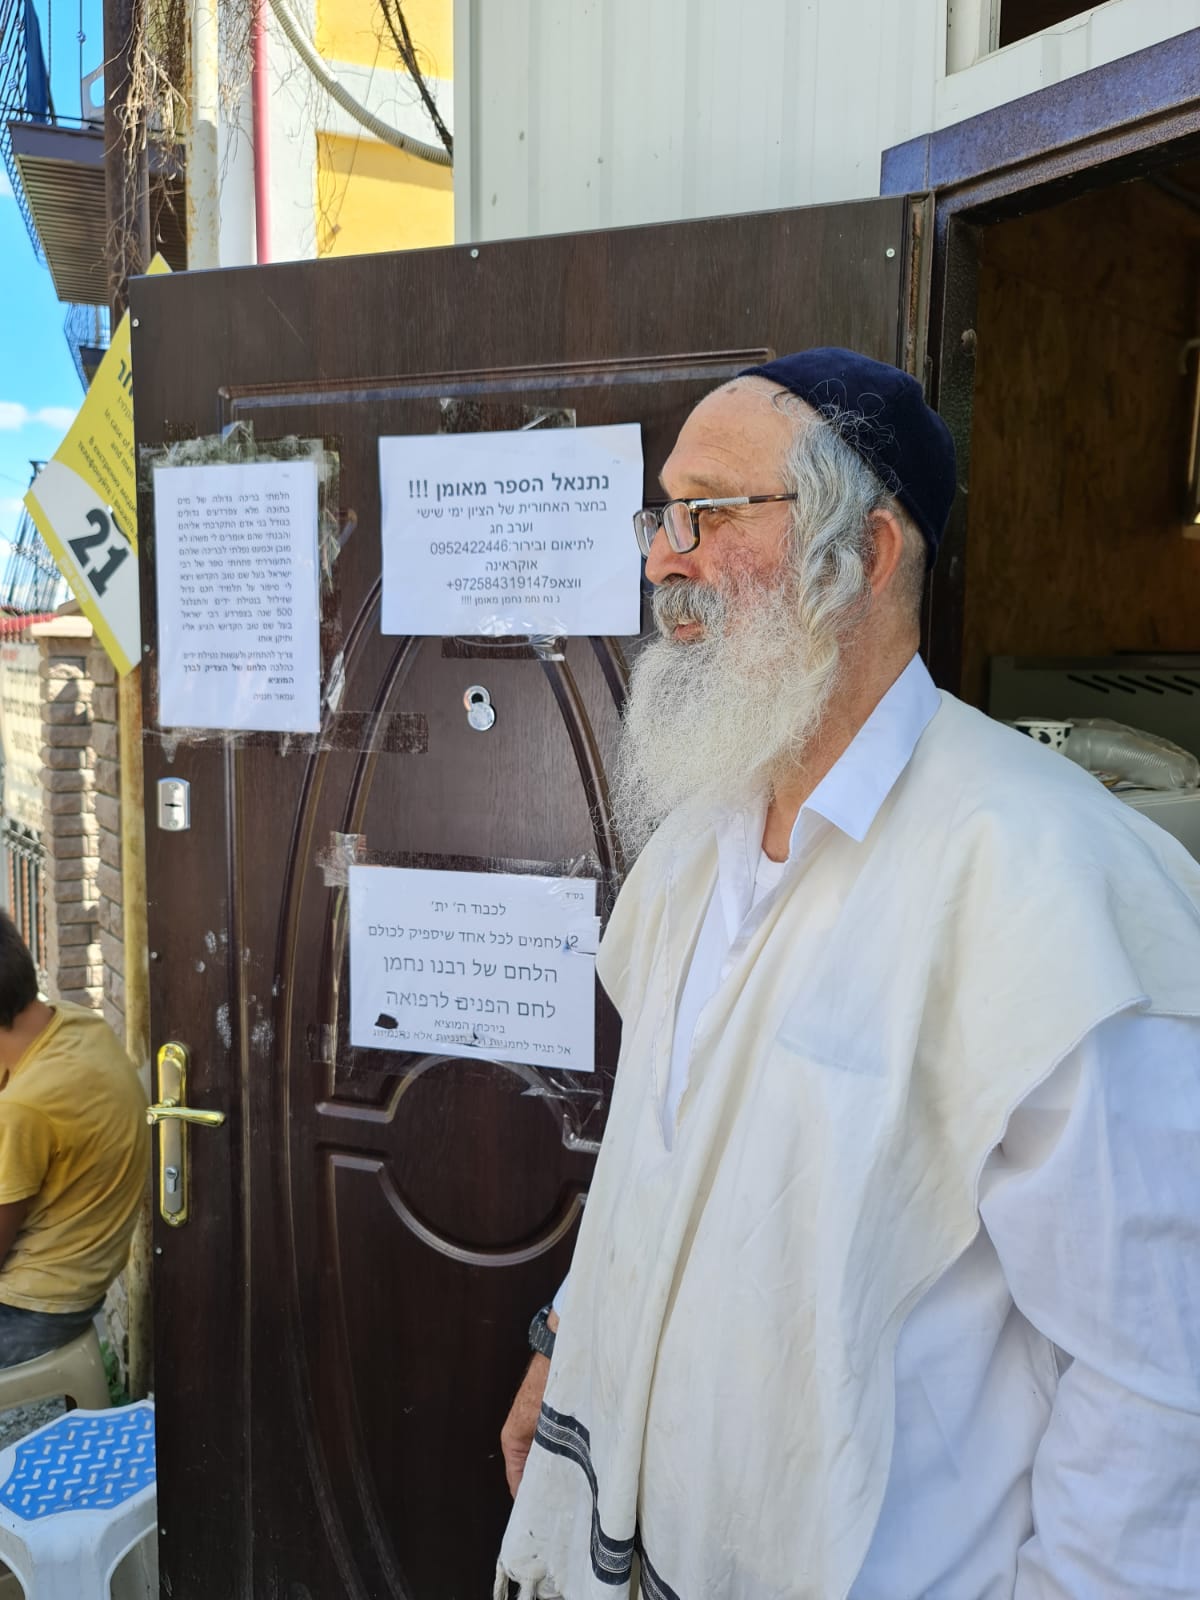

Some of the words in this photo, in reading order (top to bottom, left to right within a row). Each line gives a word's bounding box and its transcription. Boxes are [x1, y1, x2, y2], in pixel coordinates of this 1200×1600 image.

[494, 478, 544, 494] הספר
[551, 473, 609, 491] נתנאל
[409, 480, 428, 498] !!!
[436, 481, 486, 502] מאומן
[448, 506, 464, 517] ימי
[467, 505, 494, 519] הציון
[497, 503, 514, 515] של
[519, 502, 570, 514] האחורית
[575, 499, 607, 512] בחצר
[417, 508, 443, 518] שישי
[490, 524, 503, 534] חג
[507, 523, 533, 533] וערב
[551, 538, 594, 551] לתיאום
[67, 508, 129, 598] 21
[485, 561, 538, 571] אוקראינה
[471, 903, 506, 915] לכבוד
[369, 925, 404, 937] לכולם
[409, 930, 454, 943] שיספיק
[459, 932, 485, 943] אחד
[490, 933, 512, 945] לכל
[519, 935, 562, 949] לחמים
[383, 956, 423, 973] נחמן
[432, 960, 466, 975] רבנו
[472, 960, 496, 977] של
[505, 964, 557, 983] הלחם
[386, 990, 449, 1008] לרפואה
[455, 997, 509, 1015] הפנים
[518, 1000, 555, 1018] לחם
[434, 1018, 470, 1030] המוציא
